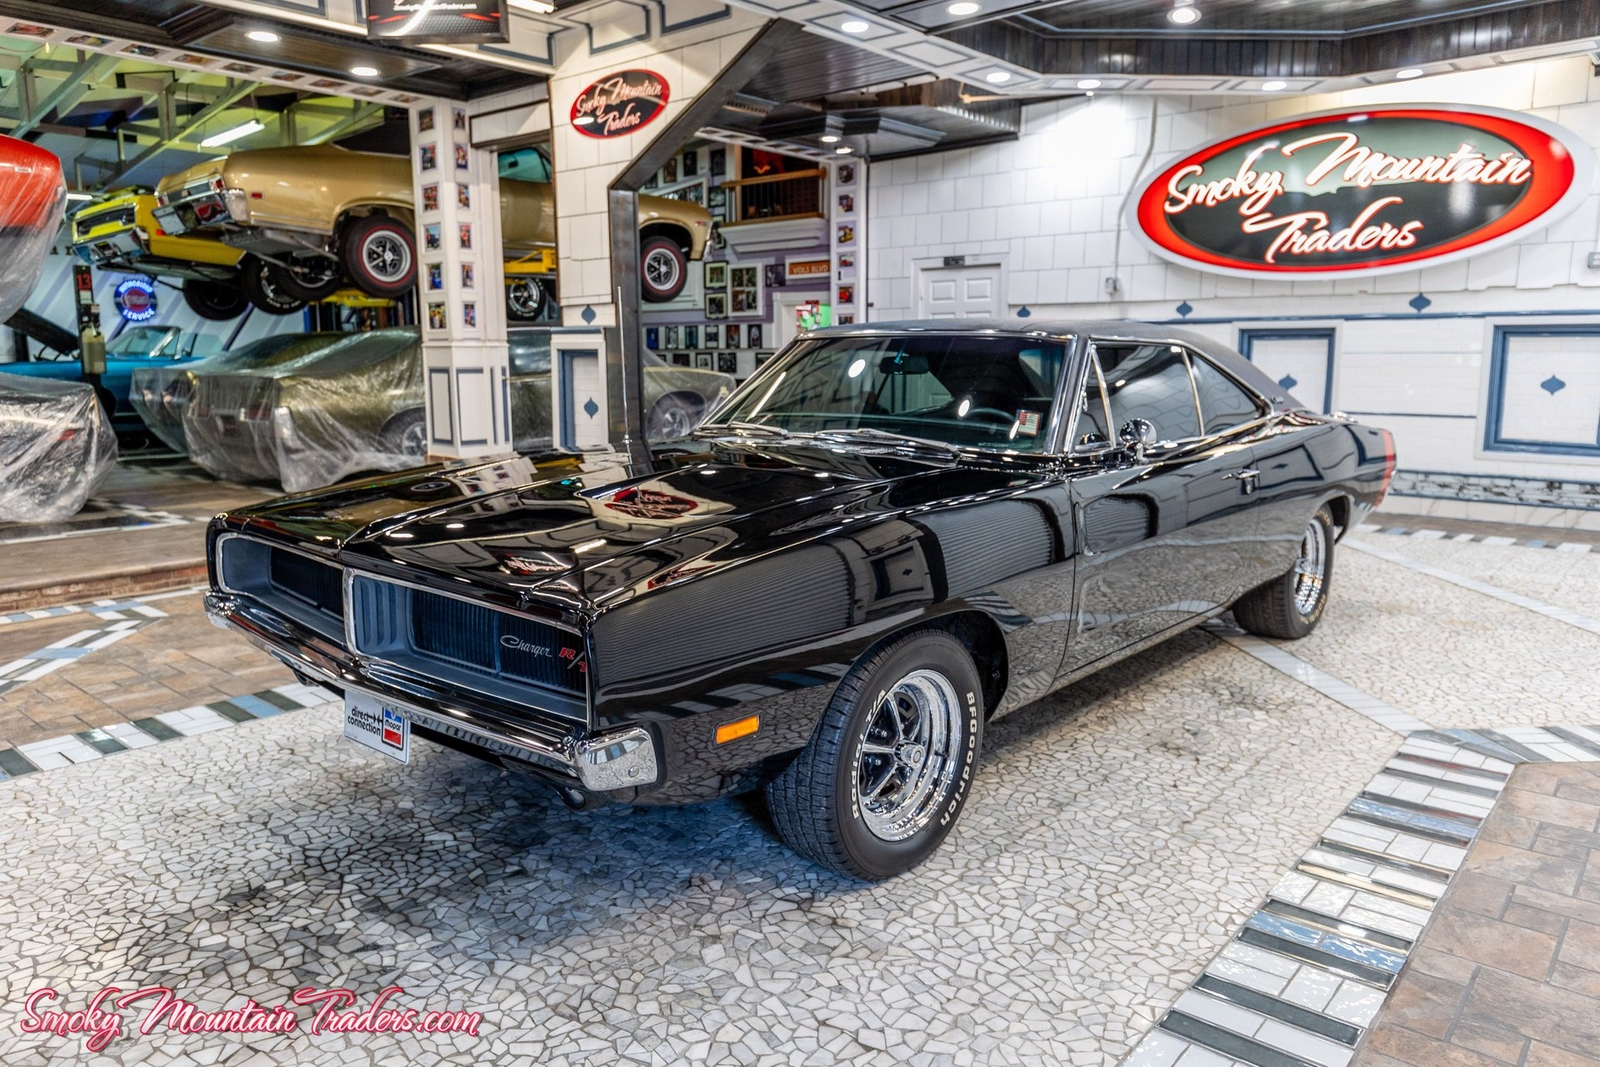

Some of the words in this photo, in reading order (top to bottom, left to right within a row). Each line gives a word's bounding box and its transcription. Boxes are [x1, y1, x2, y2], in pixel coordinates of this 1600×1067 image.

[576, 83, 607, 116] Smoky
[604, 77, 662, 100] Mountain
[597, 102, 641, 136] Traders
[1164, 145, 1284, 216] Smoky
[1281, 132, 1533, 187] Mountain
[1242, 196, 1424, 264] Traders
[76, 273, 91, 290] 13
[122, 308, 155, 320] SERVICE
[500, 635, 552, 658] Charger
[559, 647, 587, 673] R/T
[347, 715, 381, 736] connection
[351, 706, 369, 720] direct
[385, 719, 402, 731] mopar
[851, 733, 864, 819] Radial
[940, 691, 978, 826] BFGoodrich
